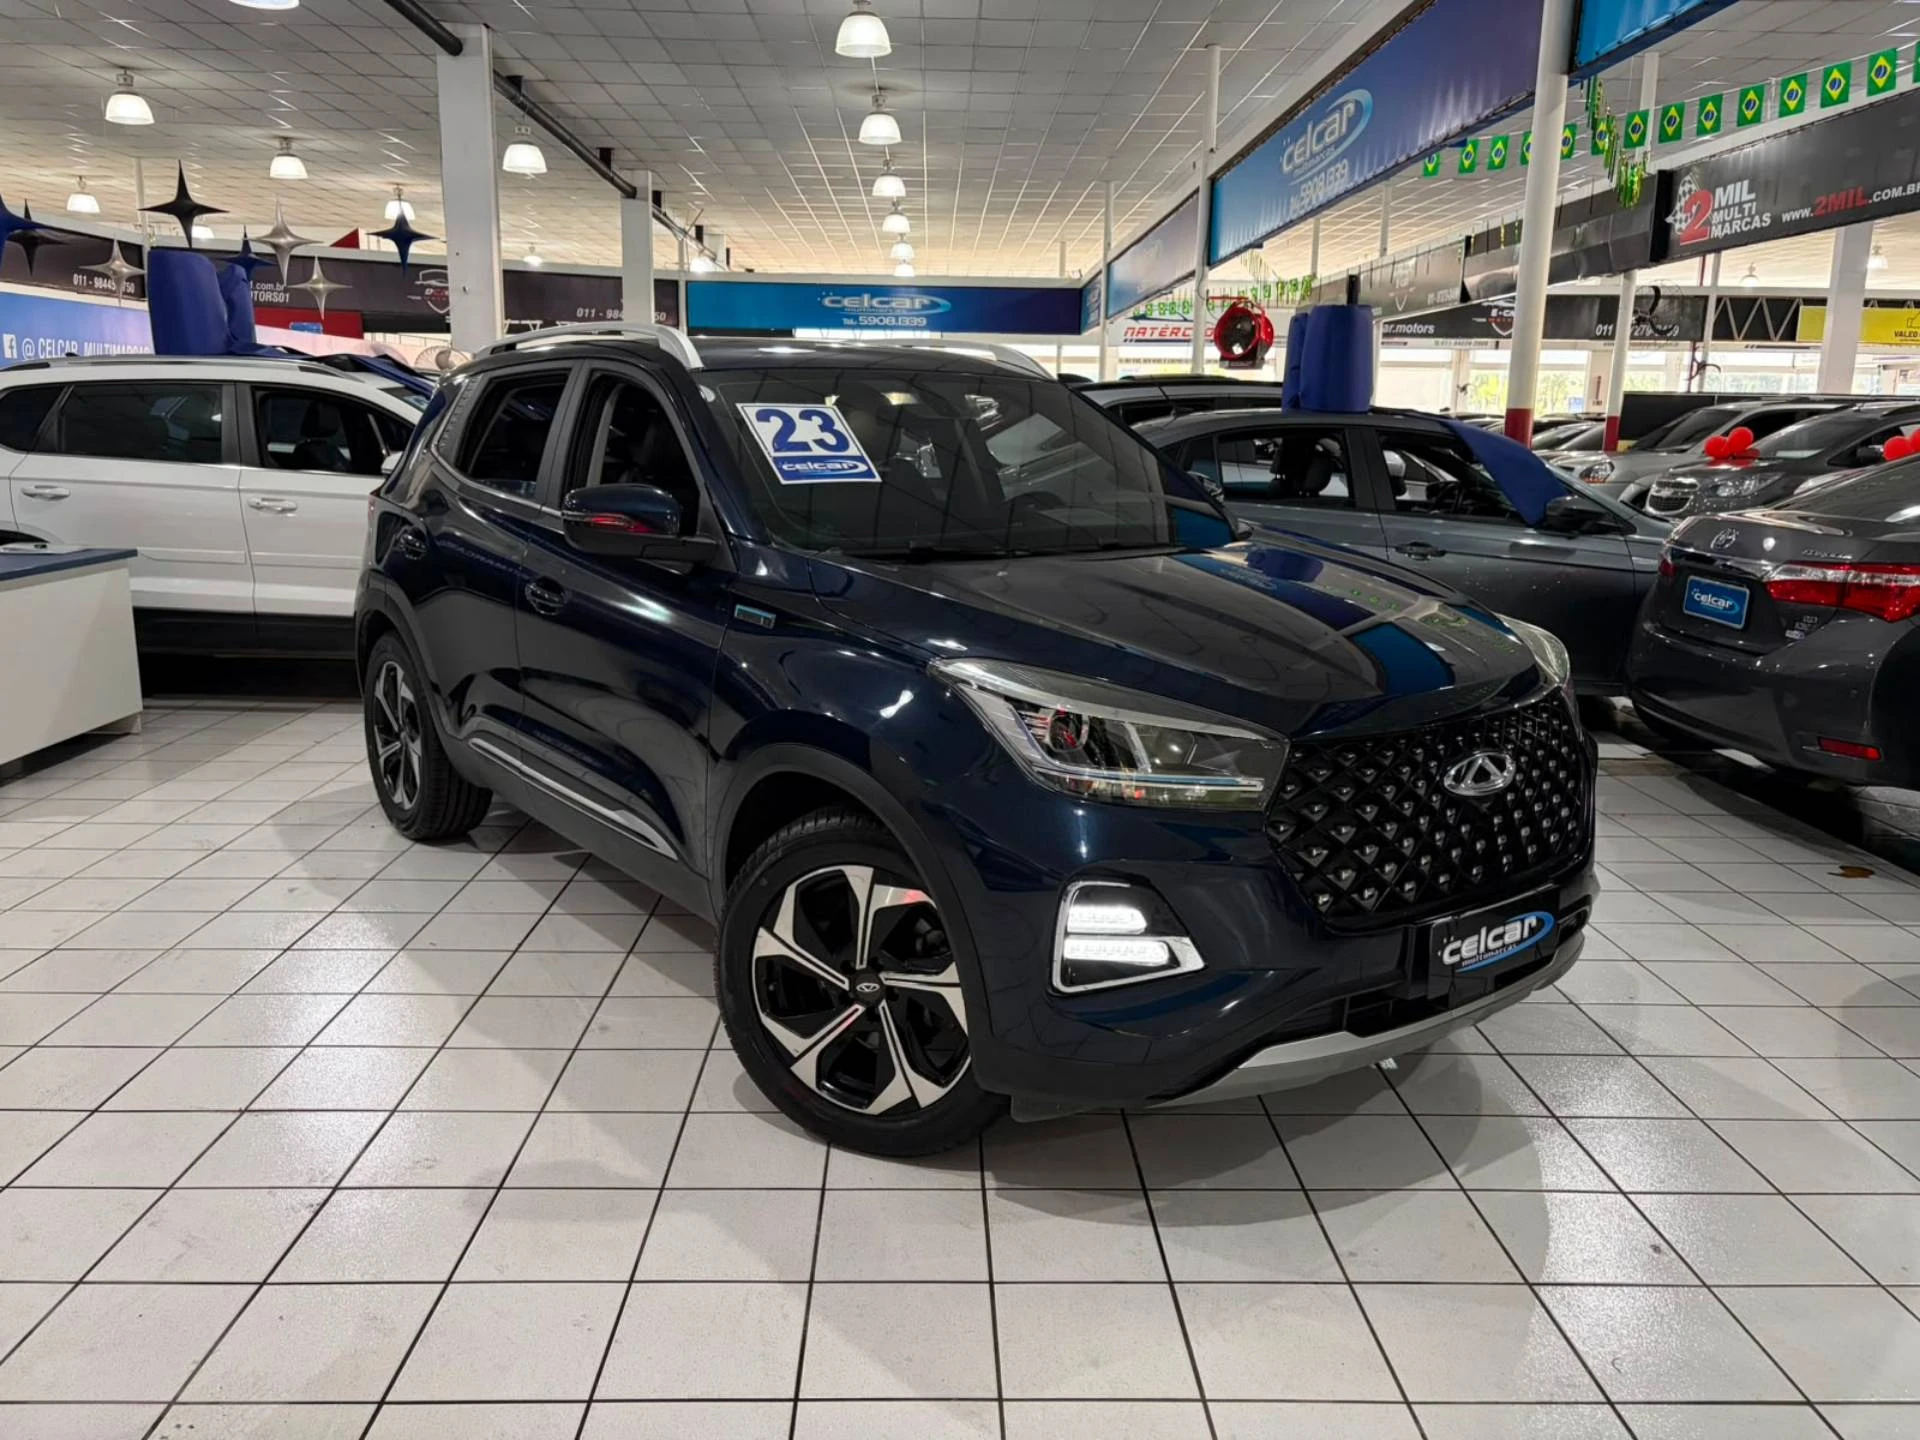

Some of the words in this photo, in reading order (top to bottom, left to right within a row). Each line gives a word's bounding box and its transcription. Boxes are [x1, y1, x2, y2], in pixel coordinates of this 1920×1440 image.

[1282, 99, 1356, 174] celcar
[1714, 180, 1756, 209] MIL
[1680, 188, 1714, 245] 2
[1710, 212, 1772, 239] MARCAS
[1711, 202, 1756, 225] MULTI
[822, 293, 931, 309] celcar
[1595, 323, 1614, 337] 011
[755, 408, 850, 453] 23
[782, 461, 856, 471] celcar
[1693, 590, 1733, 609] celcar
[1442, 915, 1537, 966] celcar
